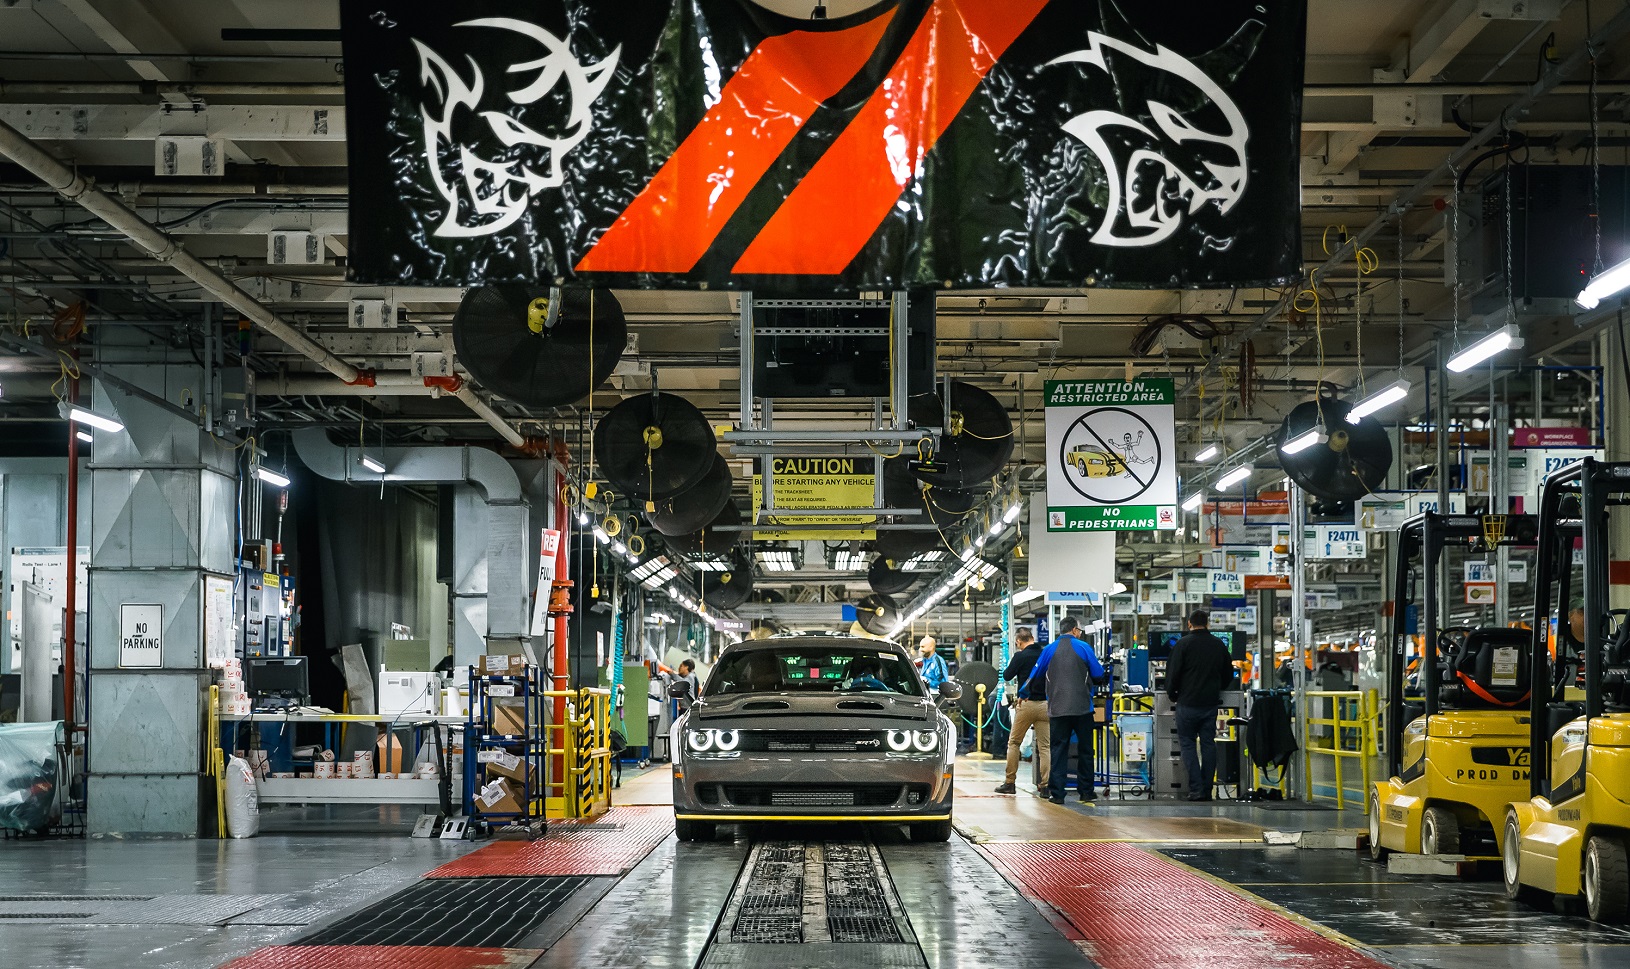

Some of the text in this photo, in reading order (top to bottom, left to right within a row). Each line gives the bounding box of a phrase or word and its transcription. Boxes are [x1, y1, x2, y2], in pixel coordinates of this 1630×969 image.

[1054, 382, 1160, 394] ATTENTION...
[1051, 393, 1165, 403] RESTRICTED AREA
[772, 458, 854, 474] CAUTION
[787, 478, 824, 486] STARTING
[825, 478, 841, 486] ANY
[842, 478, 875, 486] VEHICLE
[1103, 508, 1120, 516] NO
[1419, 502, 1457, 513] F24L
[1069, 519, 1155, 529] PEDESTRIANS
[1328, 530, 1360, 541] F2477L
[136, 622, 148, 634] NO
[123, 637, 159, 649] PARKING
[1457, 769, 1498, 780] PROD
